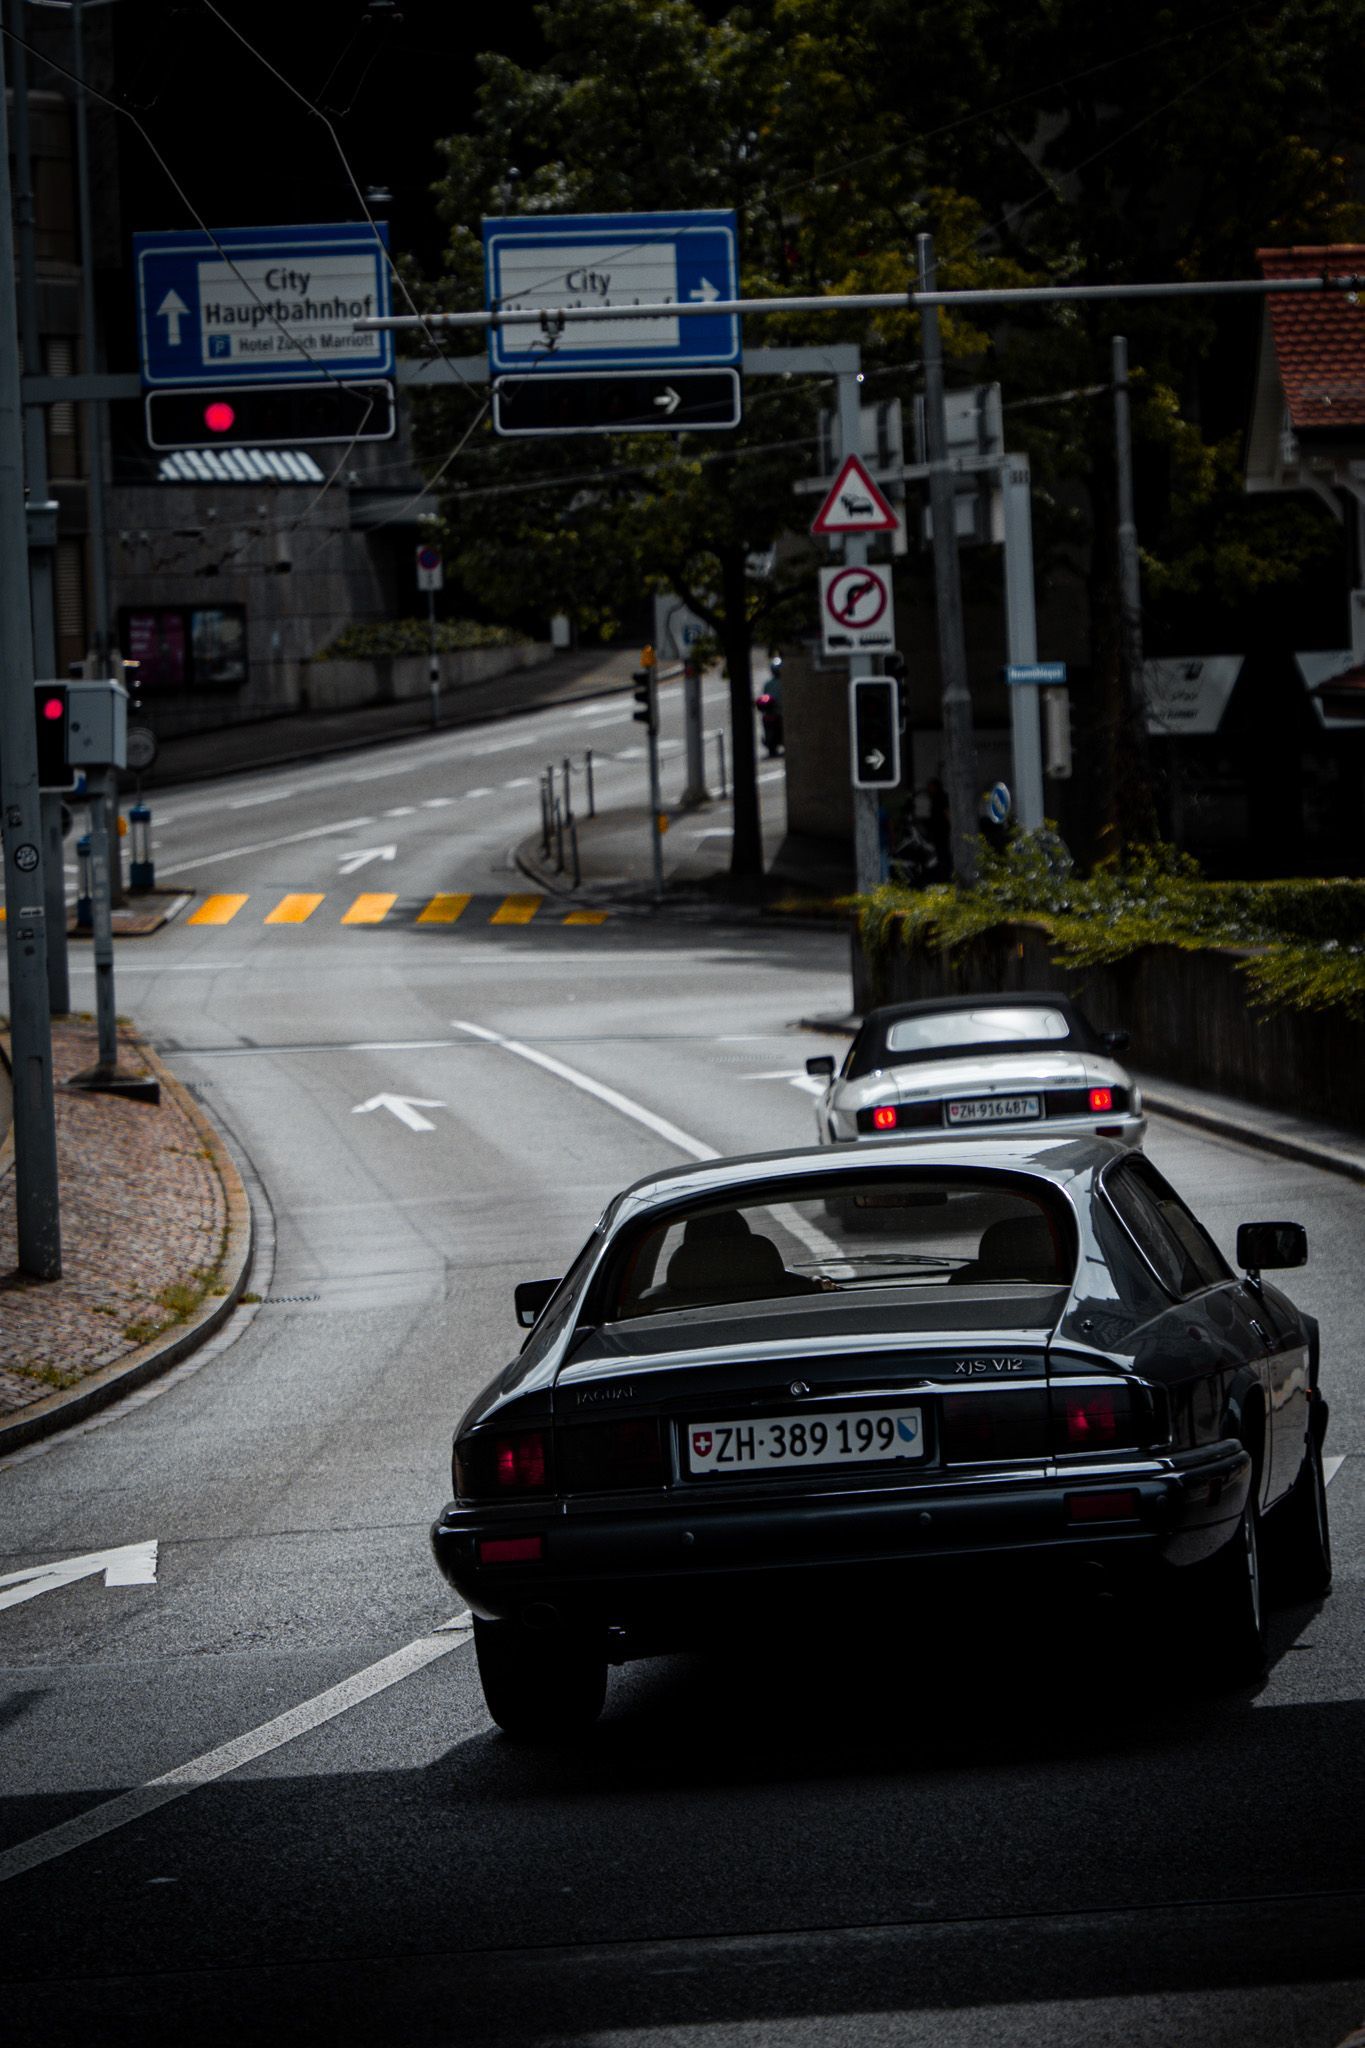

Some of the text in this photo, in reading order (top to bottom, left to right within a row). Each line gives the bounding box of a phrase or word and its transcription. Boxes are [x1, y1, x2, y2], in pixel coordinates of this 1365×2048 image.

[265, 267, 310, 294] City
[566, 268, 610, 296] City
[205, 295, 372, 327] Hauptbahnhof
[239, 336, 273, 352] Hotel
[321, 333, 374, 349] Marriott
[955, 1358, 1023, 1375] XJS V12
